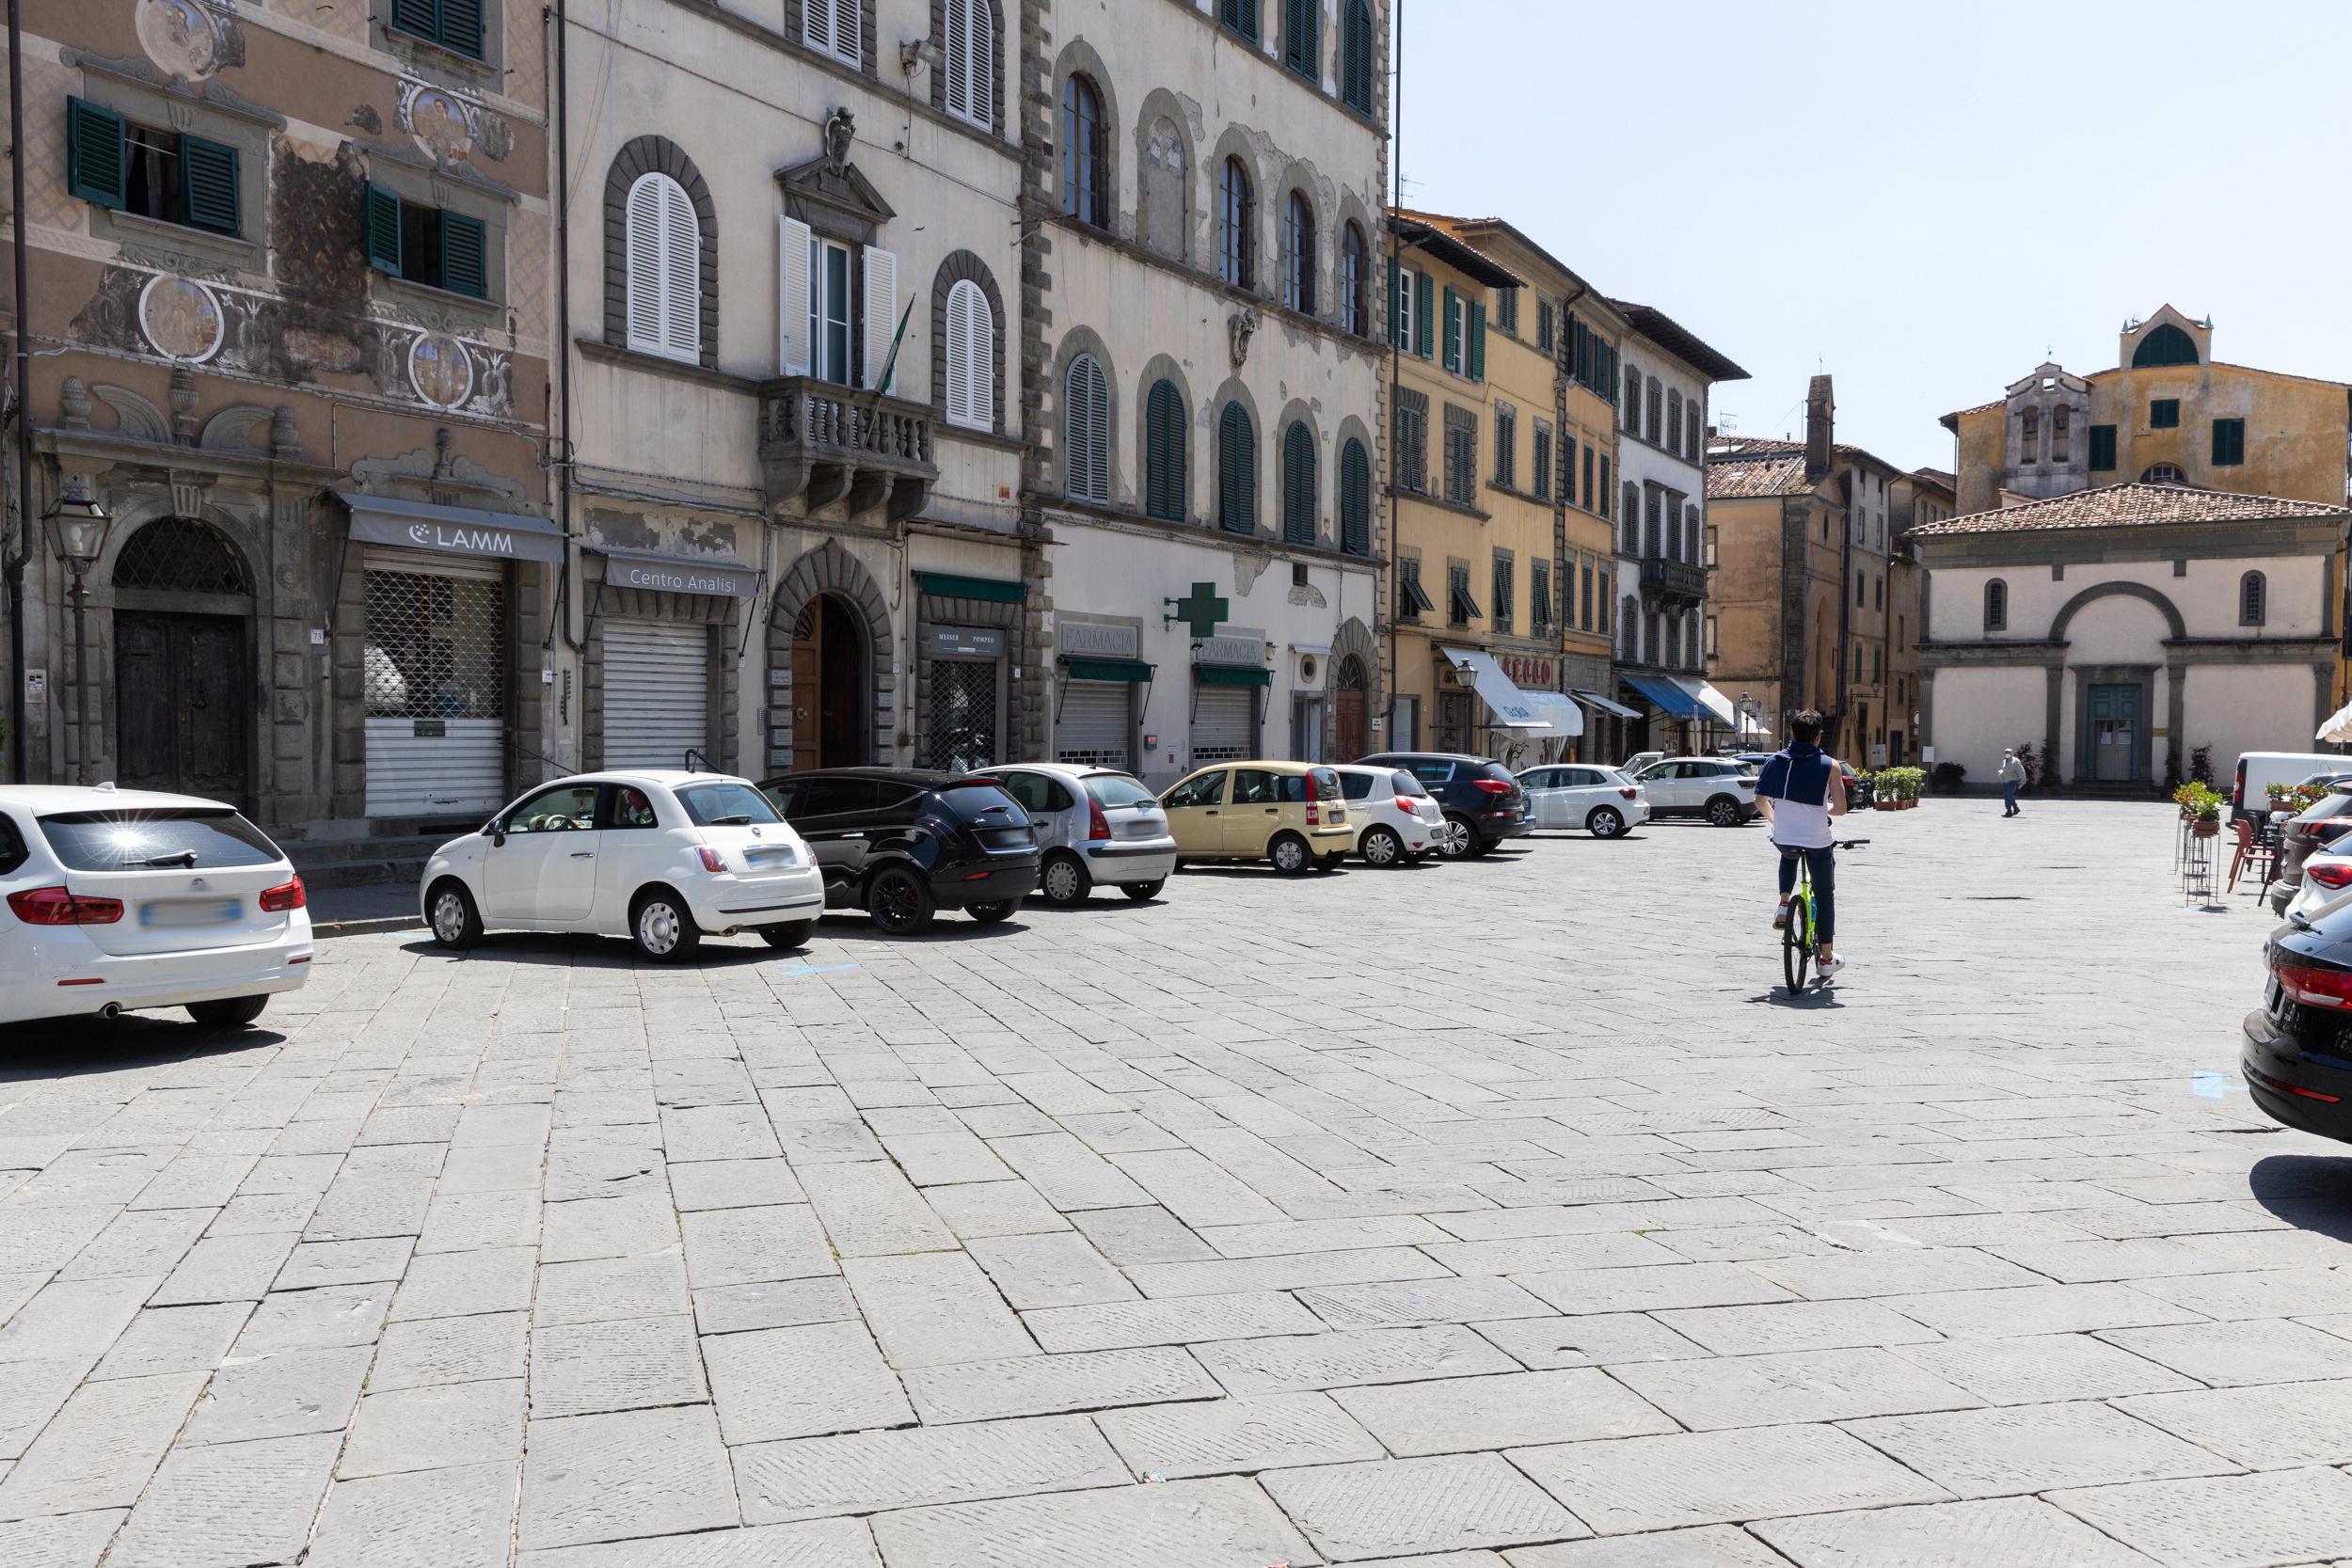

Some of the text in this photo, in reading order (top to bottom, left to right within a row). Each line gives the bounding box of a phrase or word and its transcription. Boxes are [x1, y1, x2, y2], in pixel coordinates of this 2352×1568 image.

[437, 526, 513, 553] LAMM
[630, 569, 736, 593] Centro Analisi
[1066, 628, 1134, 651] FARMACIA
[1203, 640, 1257, 661] FARMACIA
[1504, 657, 1550, 685] CECCO
